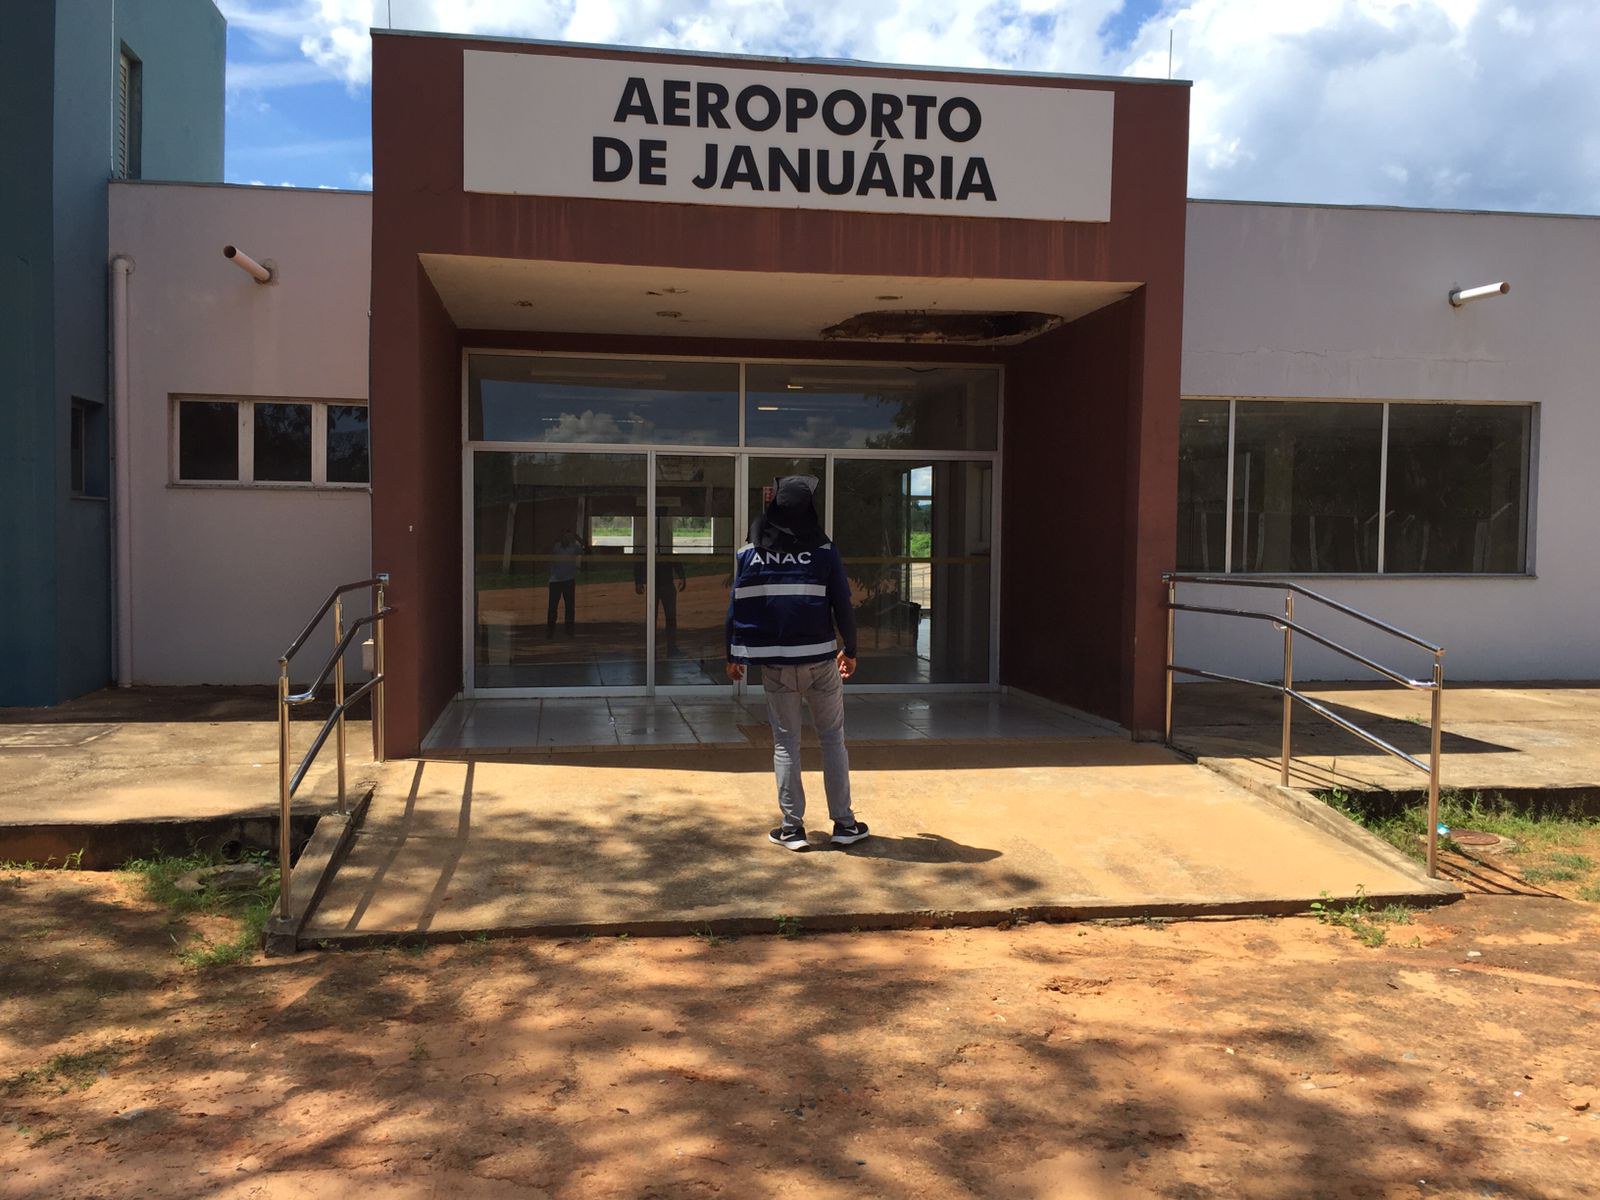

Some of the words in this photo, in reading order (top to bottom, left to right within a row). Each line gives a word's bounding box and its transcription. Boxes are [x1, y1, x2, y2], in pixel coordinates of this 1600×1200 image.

[613, 77, 981, 142] AEROPORTO
[593, 136, 667, 185] DE
[692, 140, 997, 201] JANUÁRIA
[750, 551, 812, 566] ANAC
